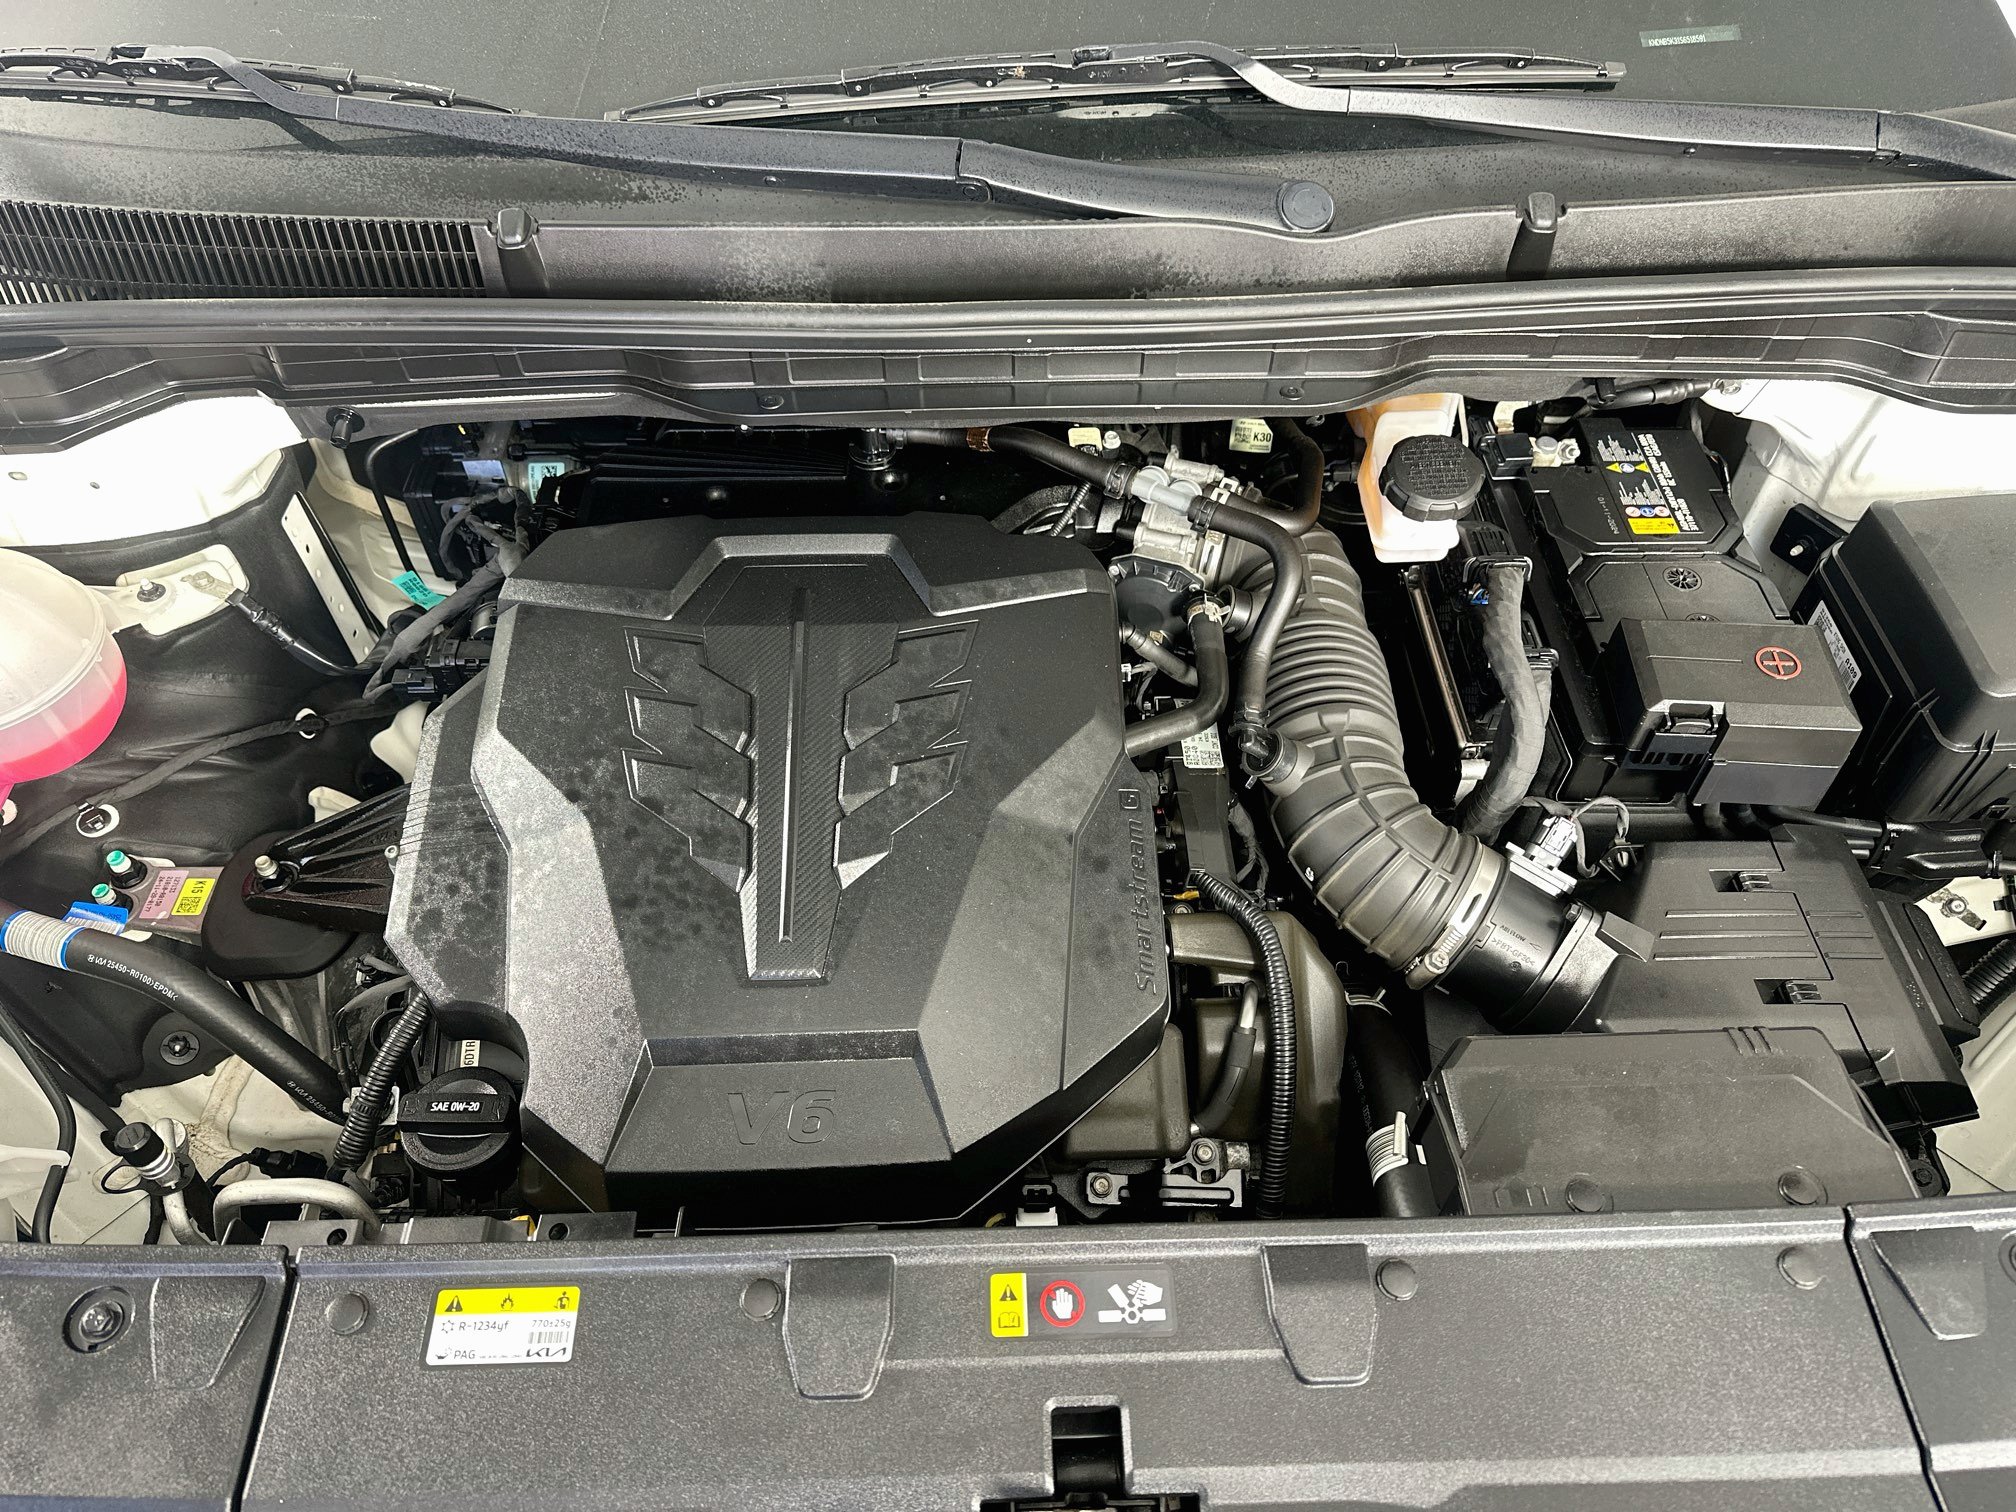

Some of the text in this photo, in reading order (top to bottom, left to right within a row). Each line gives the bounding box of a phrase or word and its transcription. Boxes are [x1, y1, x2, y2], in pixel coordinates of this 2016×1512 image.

[1253, 432, 1272, 443] K30
[191, 880, 207, 894] K15
[1128, 818, 1157, 995] Smartstream
[430, 1102, 480, 1112] SAE 0W-20
[727, 1089, 838, 1145] V6
[458, 1320, 509, 1334] R-1234yf
[532, 1319, 572, 1329] 770±25g
[453, 1350, 476, 1360] PAG
[526, 1347, 567, 1358] KIA
